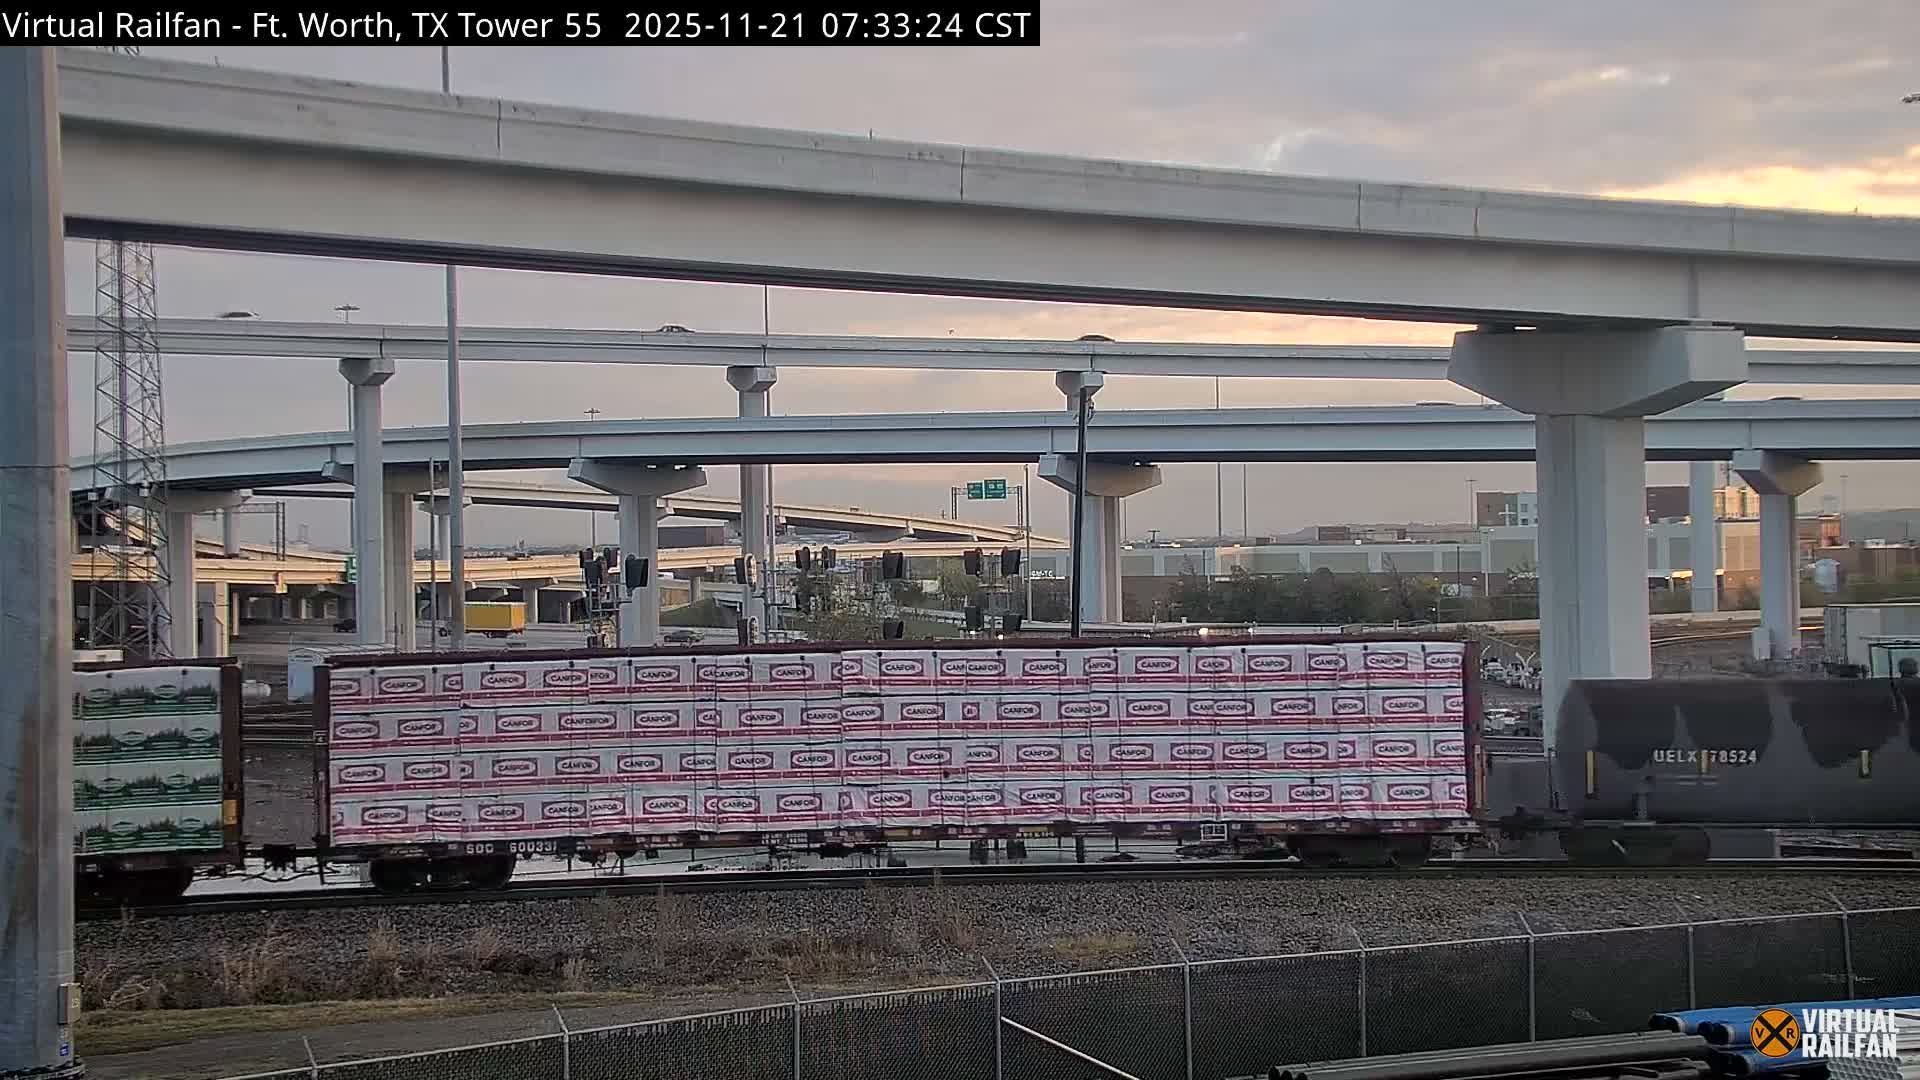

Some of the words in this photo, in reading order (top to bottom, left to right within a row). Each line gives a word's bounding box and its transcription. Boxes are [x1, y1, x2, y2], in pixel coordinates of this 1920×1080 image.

[487, 676, 520, 684] CANFOR
[1217, 703, 1246, 711] CANFOR
[845, 709, 875, 717] CANFOR
[404, 723, 435, 731] CANFOR
[502, 719, 533, 727] CANFOR
[341, 727, 372, 735] CANFOR
[1653, 749, 1697, 763] UELX
[624, 760, 655, 768] CANFOR
[735, 757, 766, 765] CANFOR
[499, 763, 530, 771] CANFOR
[345, 770, 377, 778] CANFOR
[1027, 792, 1056, 800] CANFOR
[650, 801, 680, 809] CANFOR
[484, 808, 517, 817] CANFOR
